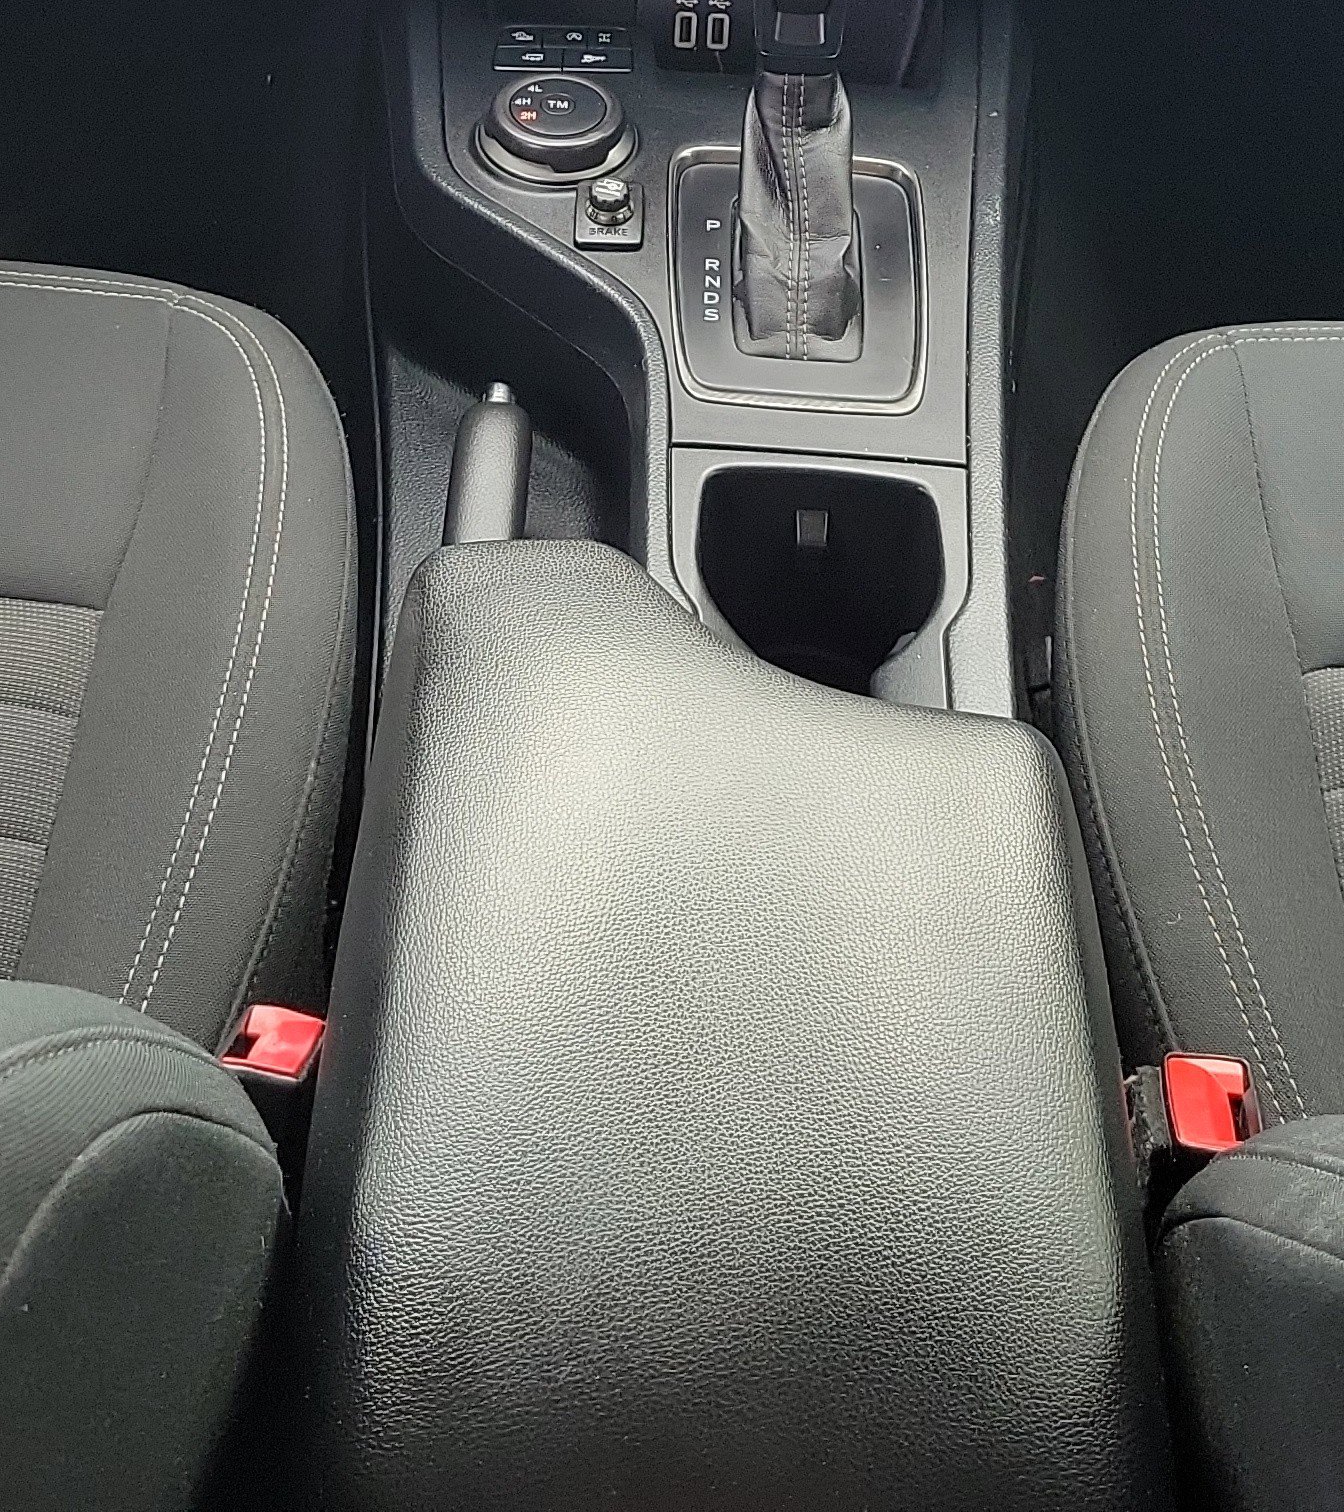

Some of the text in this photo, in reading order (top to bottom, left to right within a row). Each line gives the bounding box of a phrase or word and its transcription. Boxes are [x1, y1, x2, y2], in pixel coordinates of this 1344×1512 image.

[547, 100, 568, 109] TM
[520, 111, 536, 120] 2H
[706, 219, 721, 231] P
[588, 227, 628, 236] BRAKE
[705, 258, 720, 271] R
[705, 275, 721, 288] N
[703, 291, 720, 304] D
[703, 308, 719, 321] S
